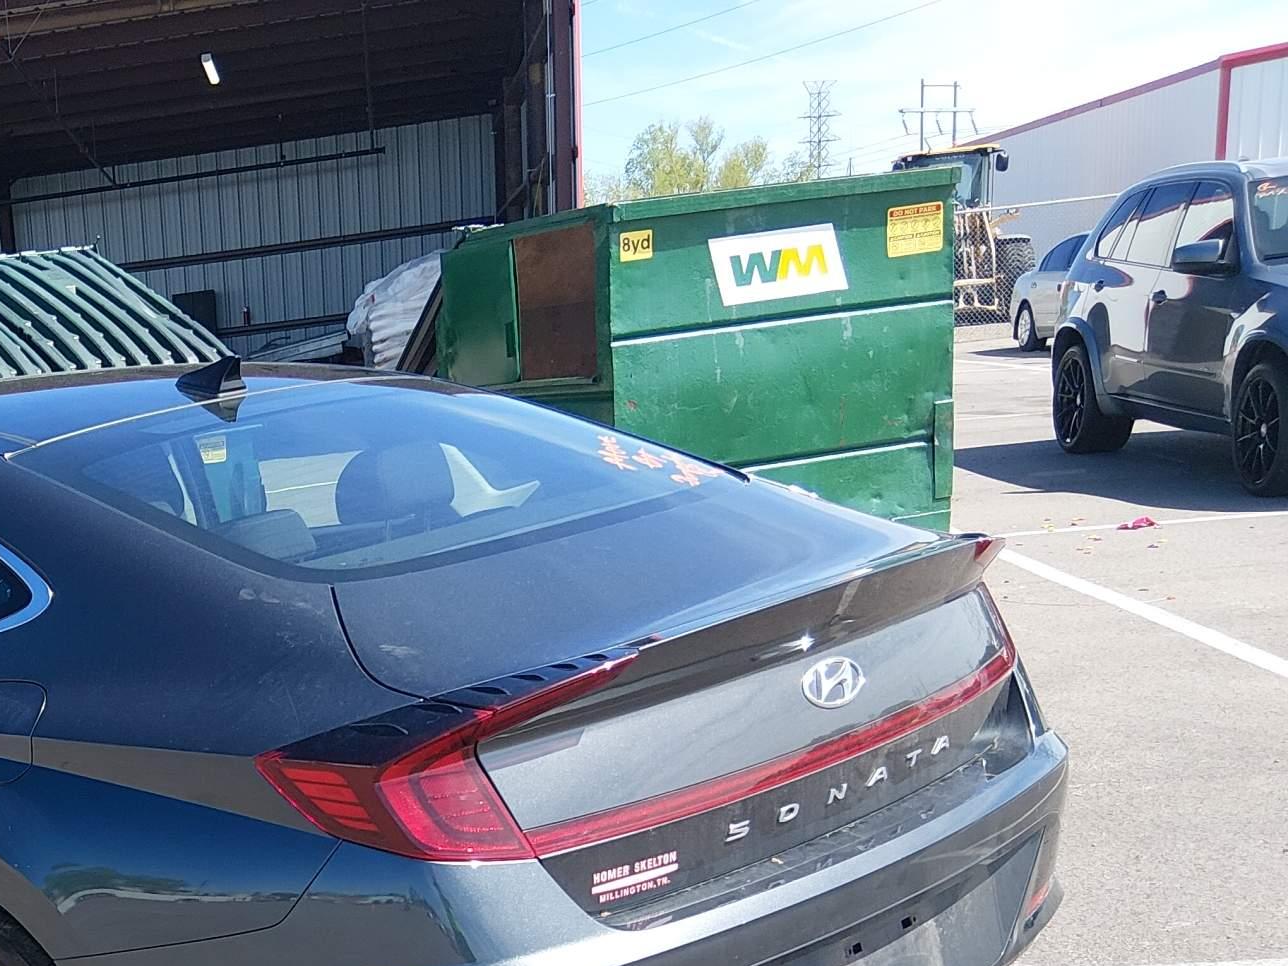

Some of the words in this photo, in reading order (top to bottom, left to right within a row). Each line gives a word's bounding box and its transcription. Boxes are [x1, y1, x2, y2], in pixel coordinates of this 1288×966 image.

[622, 234, 650, 254] 8yd
[730, 244, 828, 287] WM
[725, 735, 950, 843] SONATA
[593, 865, 630, 884] HOMER
[634, 851, 677, 873] SKELTON
